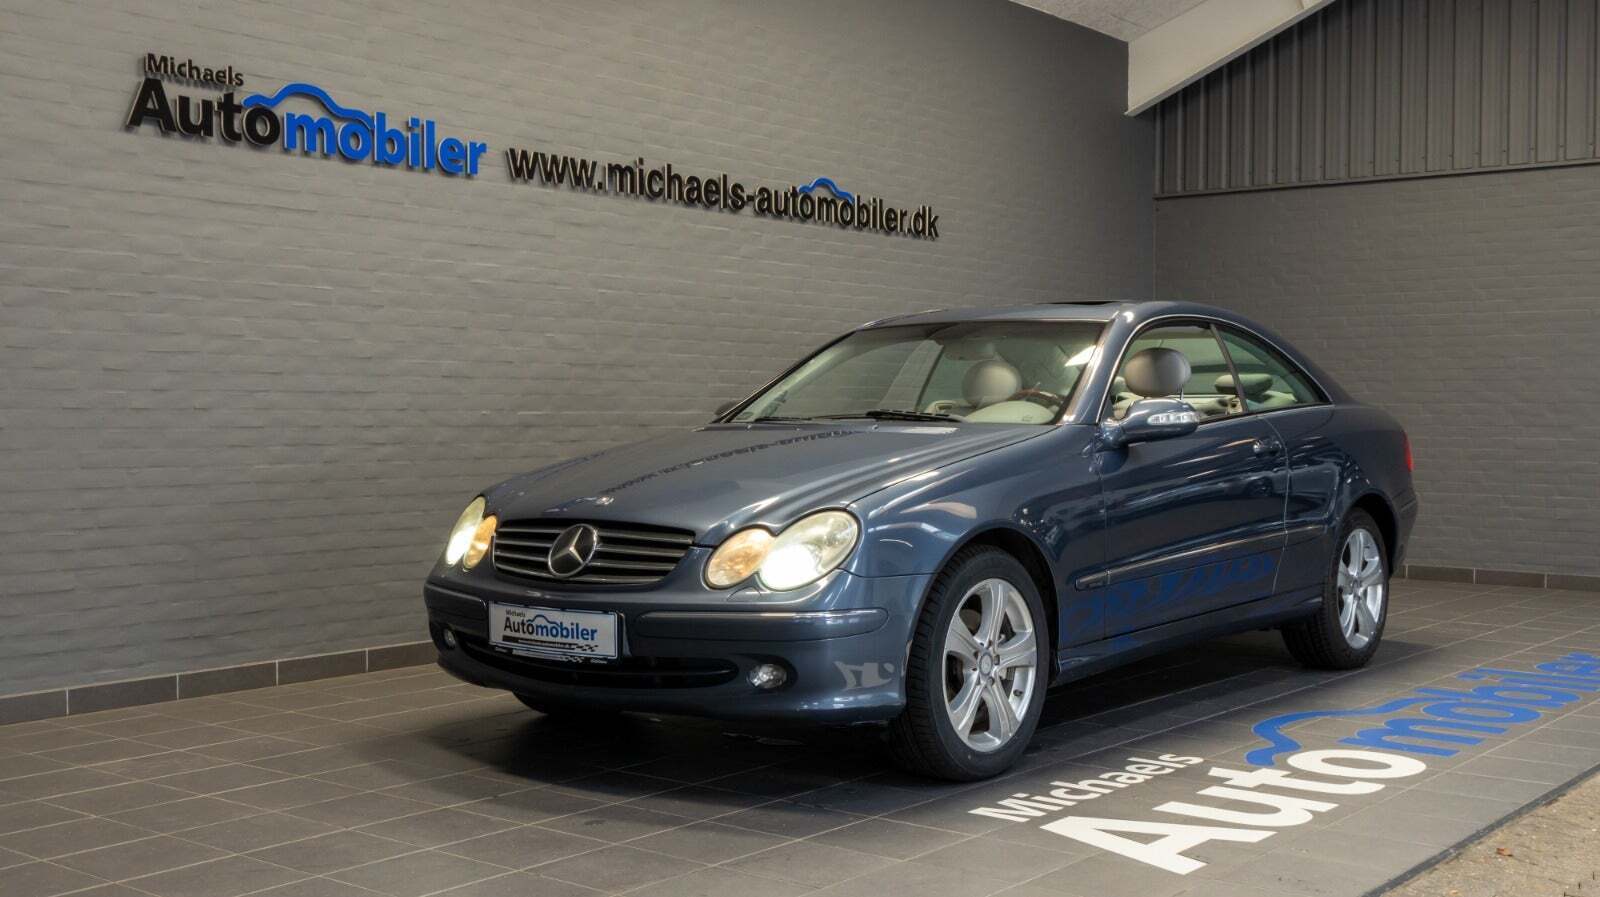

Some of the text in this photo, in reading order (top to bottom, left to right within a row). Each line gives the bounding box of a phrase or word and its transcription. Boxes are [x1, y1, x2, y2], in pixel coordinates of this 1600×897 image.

[145, 53, 244, 86] Michaels
[126, 78, 487, 175] Automobiler
[506, 147, 939, 239] www.michaels-automobiler.dk
[504, 617, 597, 641] Automobiler
[968, 752, 1204, 823] Michaels
